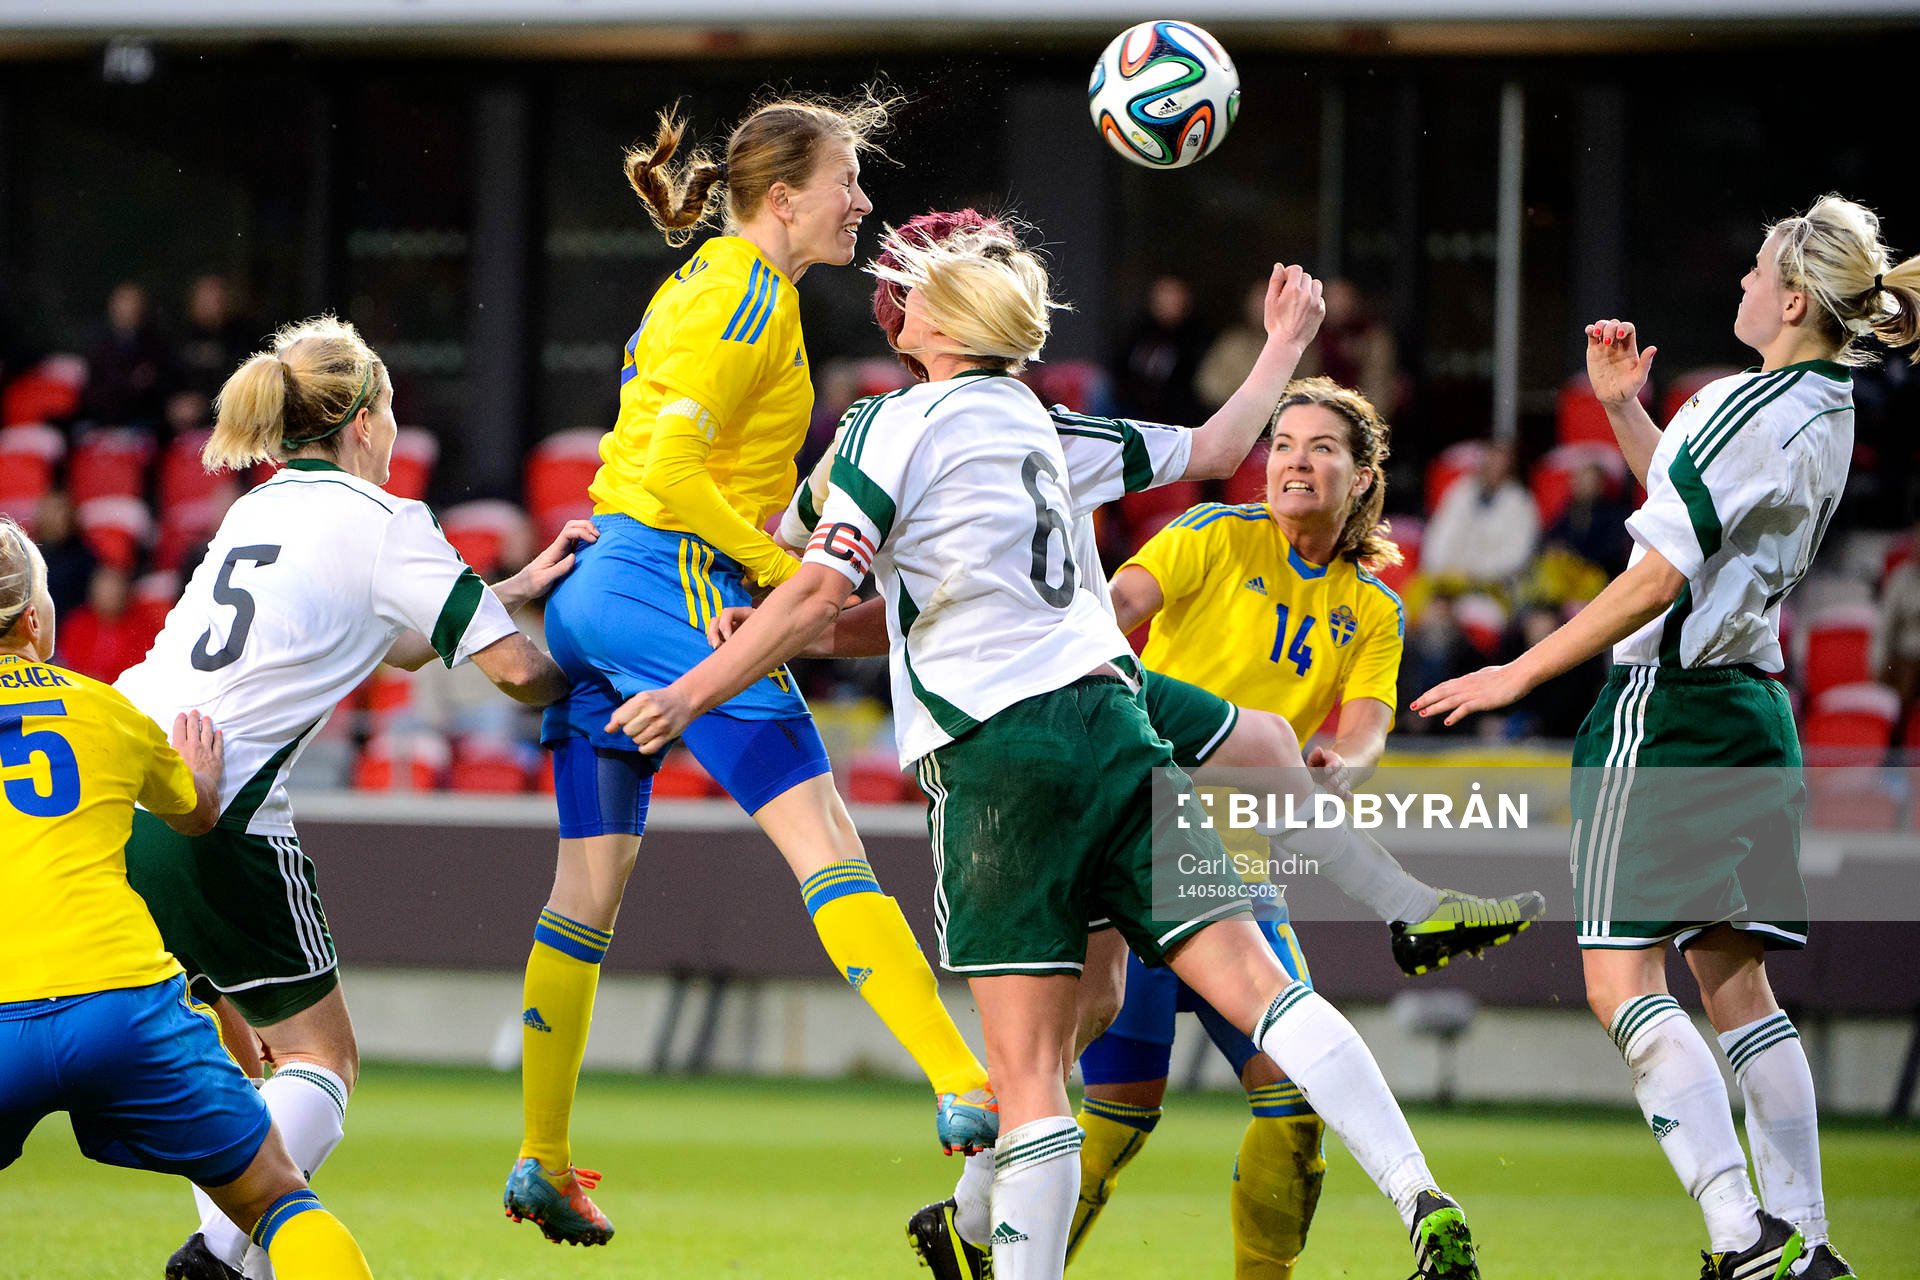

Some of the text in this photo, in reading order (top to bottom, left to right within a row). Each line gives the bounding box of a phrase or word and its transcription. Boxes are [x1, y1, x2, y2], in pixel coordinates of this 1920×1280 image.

[824, 522, 862, 561] C
[1021, 451, 1075, 608] 6
[191, 544, 282, 672] 5
[1269, 603, 1316, 677] 14
[0, 666, 72, 688] CHER
[0, 698, 81, 818] 5
